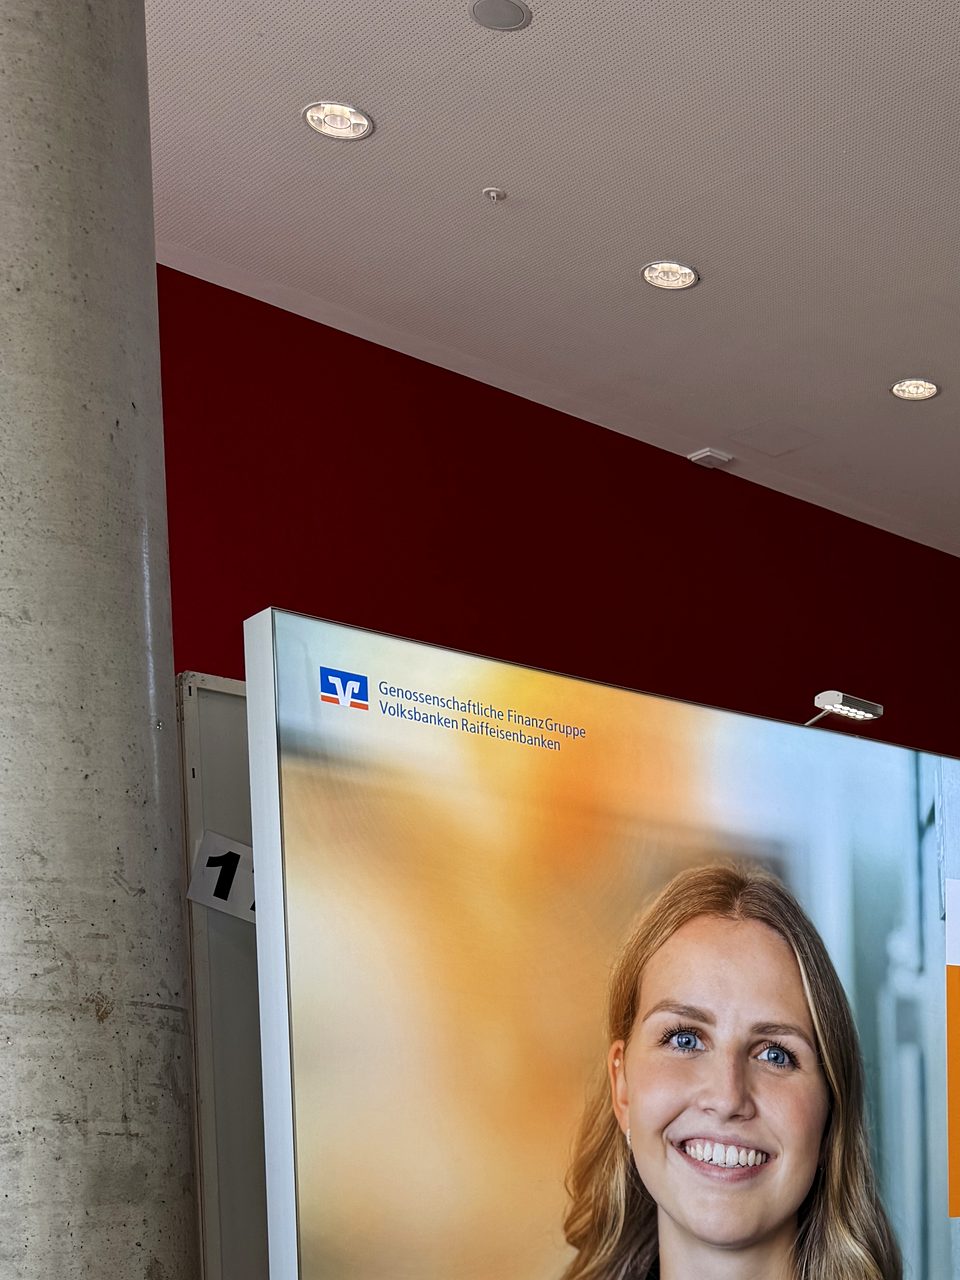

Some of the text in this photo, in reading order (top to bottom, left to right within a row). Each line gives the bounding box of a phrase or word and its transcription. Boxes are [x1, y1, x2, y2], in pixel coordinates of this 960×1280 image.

[378, 681, 586, 739] Genossenschaftliche FinanzGruppe
[378, 700, 561, 751] Volksbanken Raiffeisenbanken
[206, 851, 256, 912] 1
